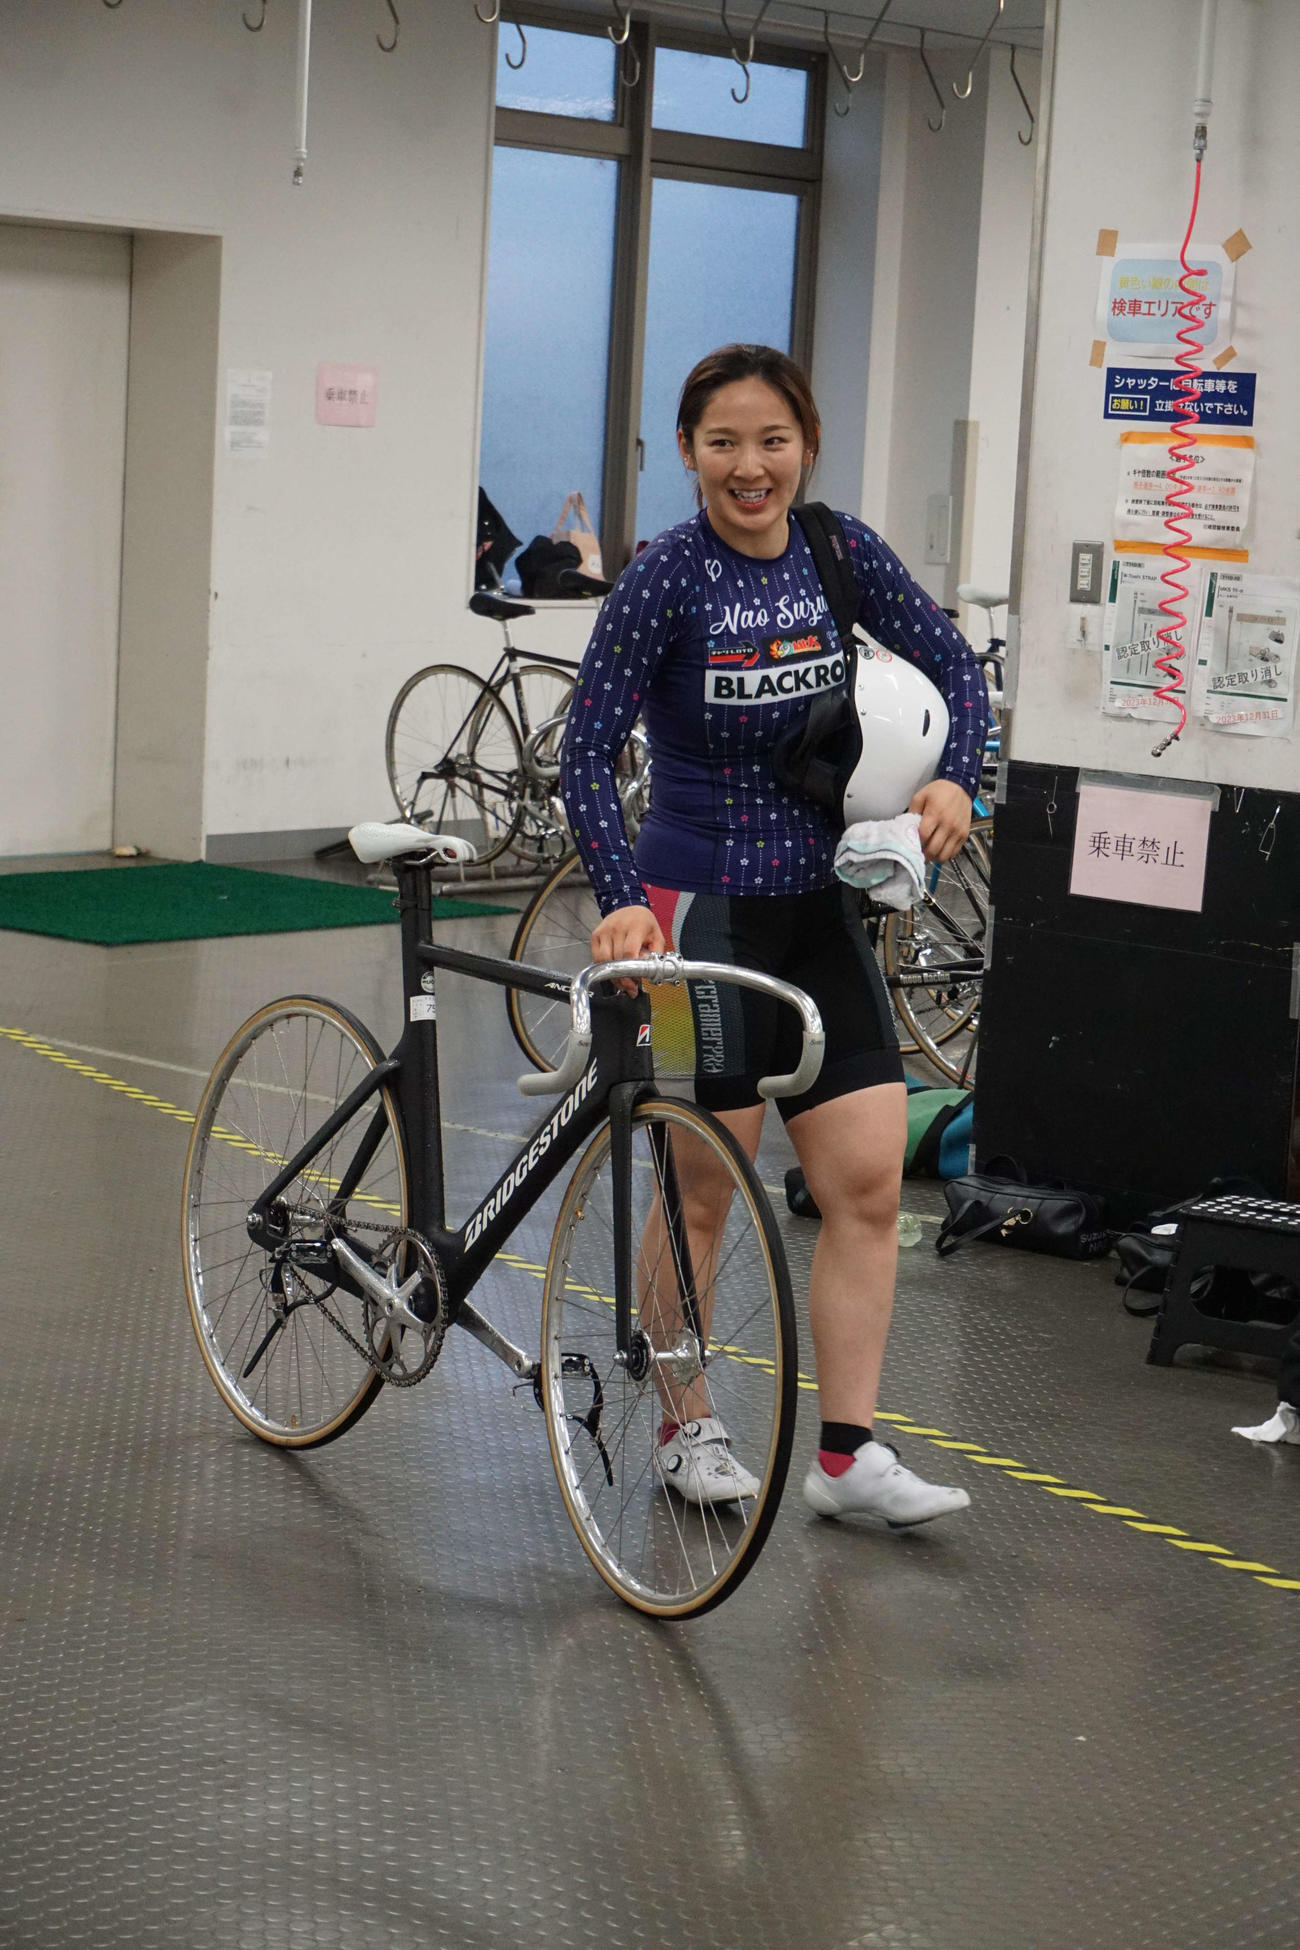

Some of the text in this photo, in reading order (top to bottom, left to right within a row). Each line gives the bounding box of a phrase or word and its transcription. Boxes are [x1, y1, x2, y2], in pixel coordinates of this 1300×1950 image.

[1154, 399, 1248, 416] 立掛ないで下さい。
[709, 602, 770, 635] Nao
[713, 658, 845, 700] BLACKRO
[1211, 665, 1282, 690] 認定取り消し
[1087, 831, 1185, 868] 乗車禁止
[544, 982, 594, 998] ANCR
[464, 1057, 598, 1253] BRIDGESTONE
